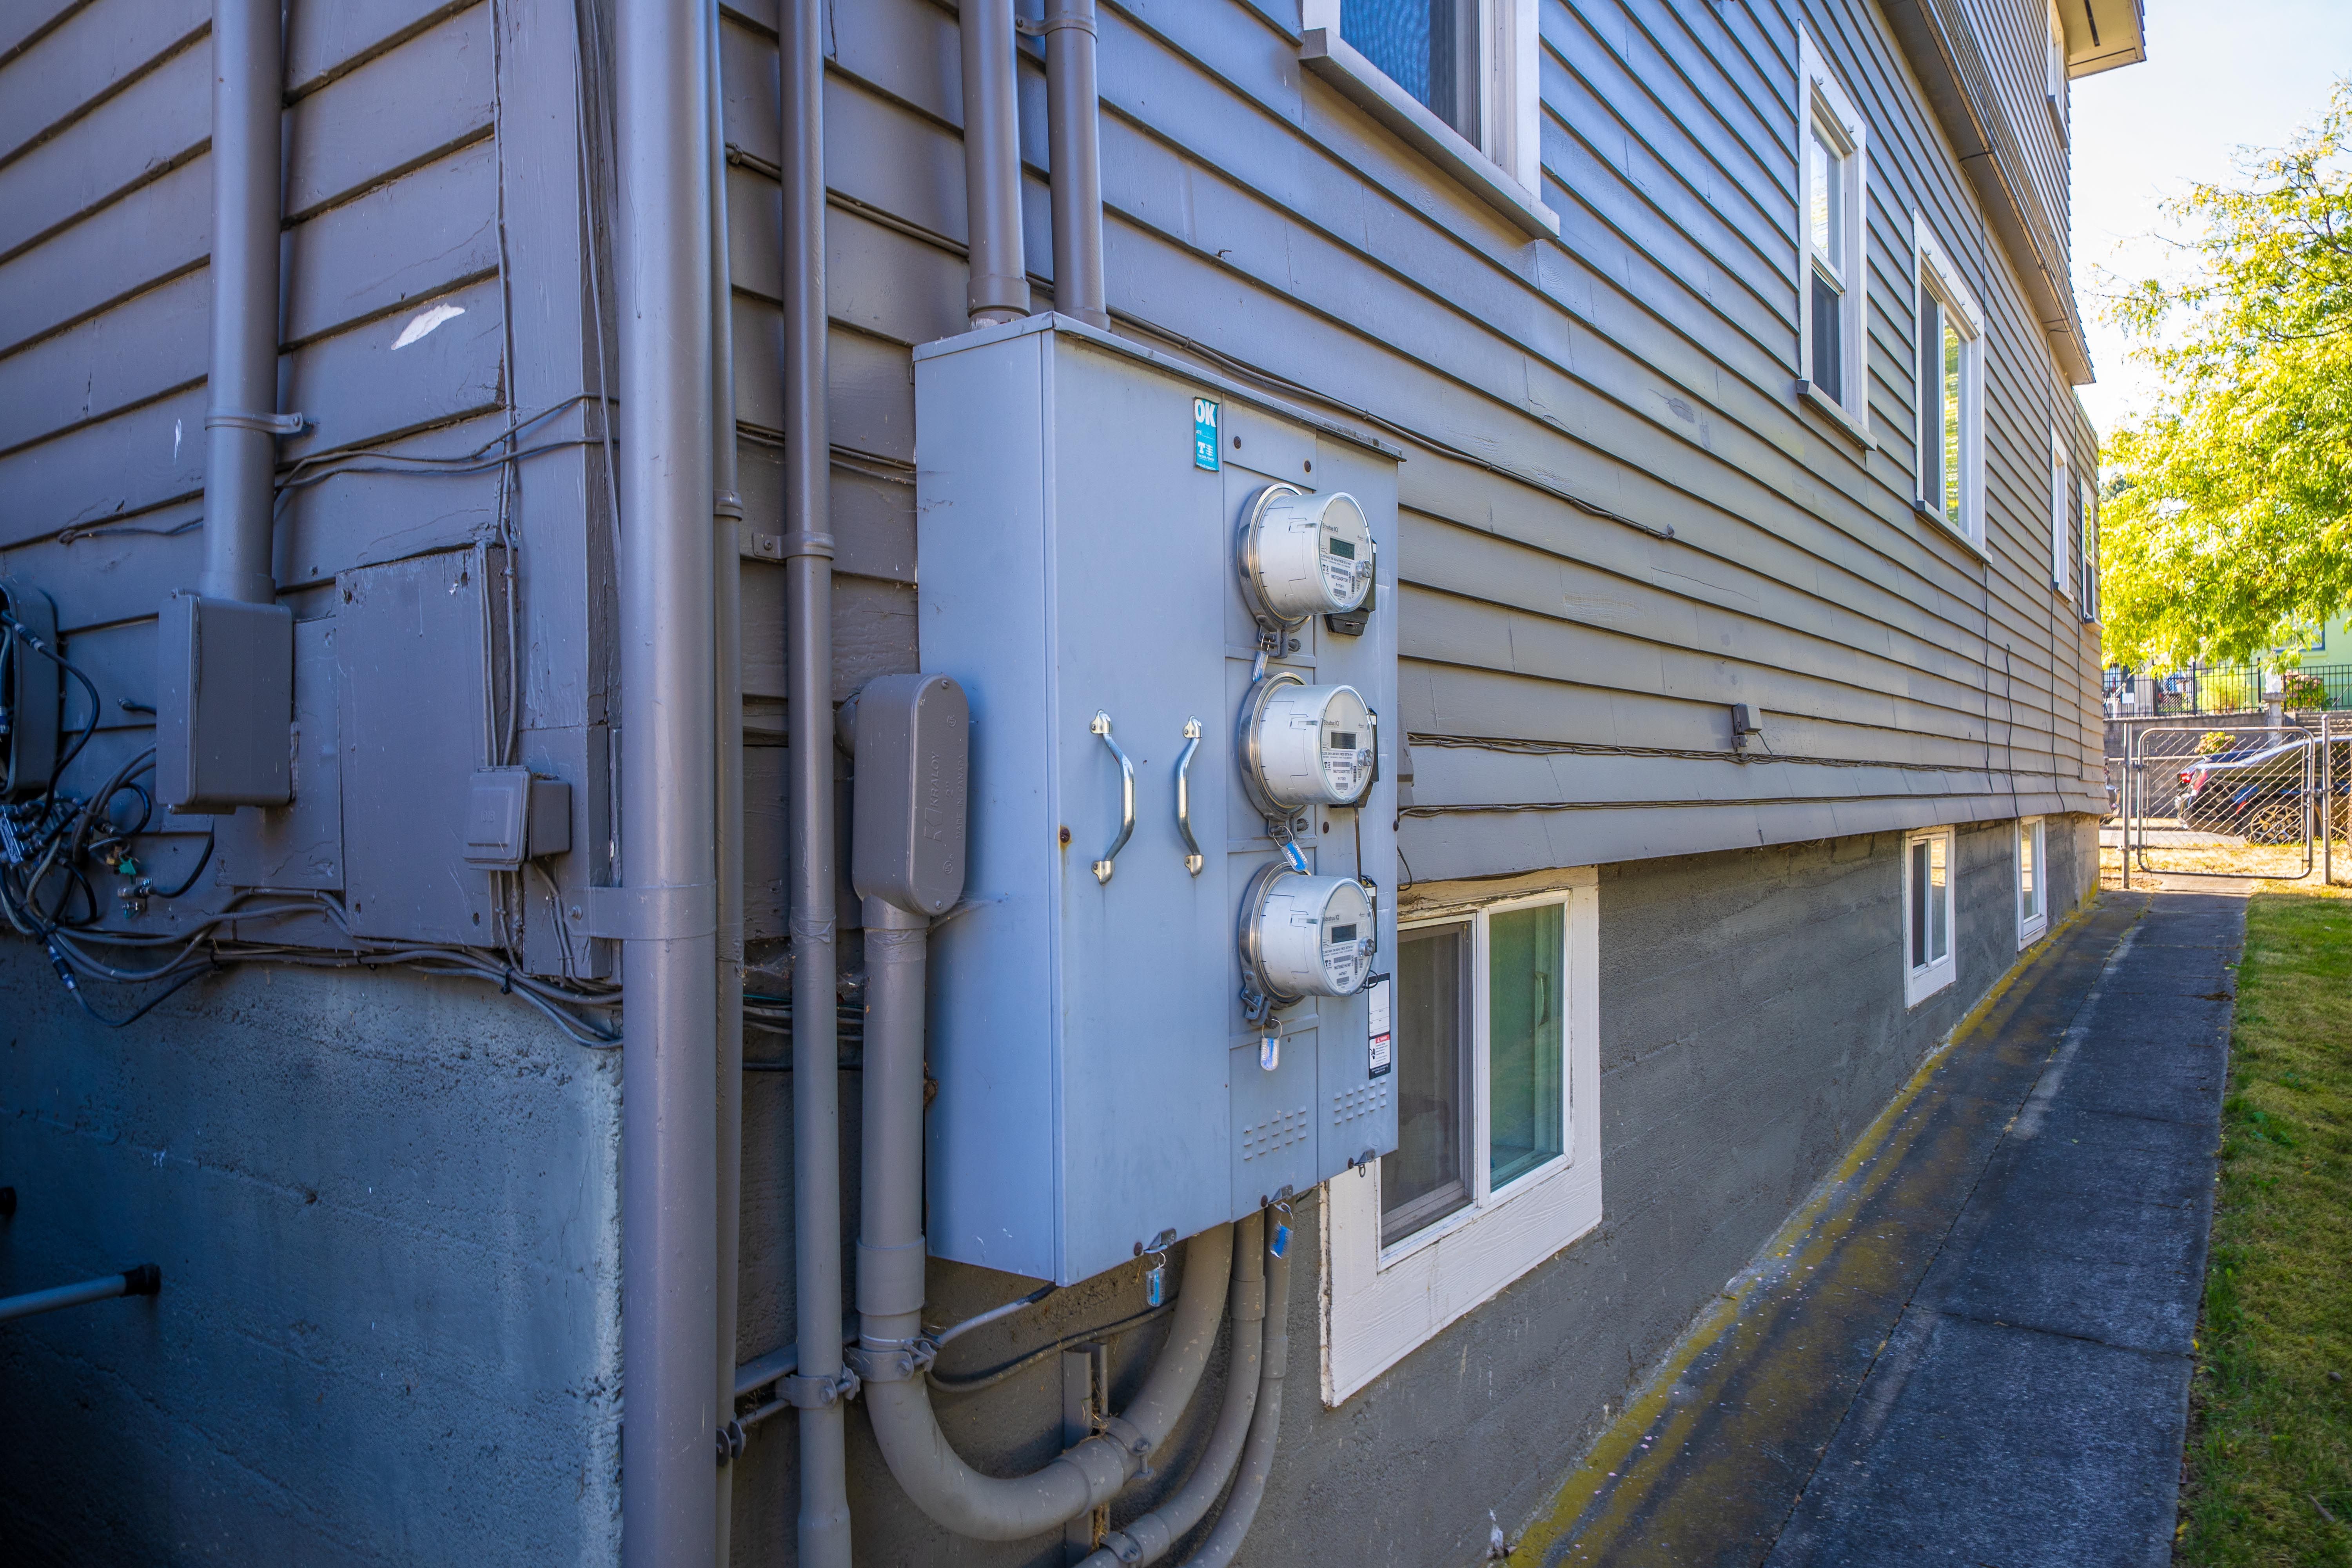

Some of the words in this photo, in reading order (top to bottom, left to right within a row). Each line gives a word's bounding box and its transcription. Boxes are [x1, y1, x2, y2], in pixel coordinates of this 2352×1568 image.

[1195, 399, 1216, 427] OK
[1323, 523, 1334, 531] Stratus
[930, 751, 939, 808] KRALOY
[957, 798, 963, 807] IN
[1287, 851, 1298, 866] TACOMA
